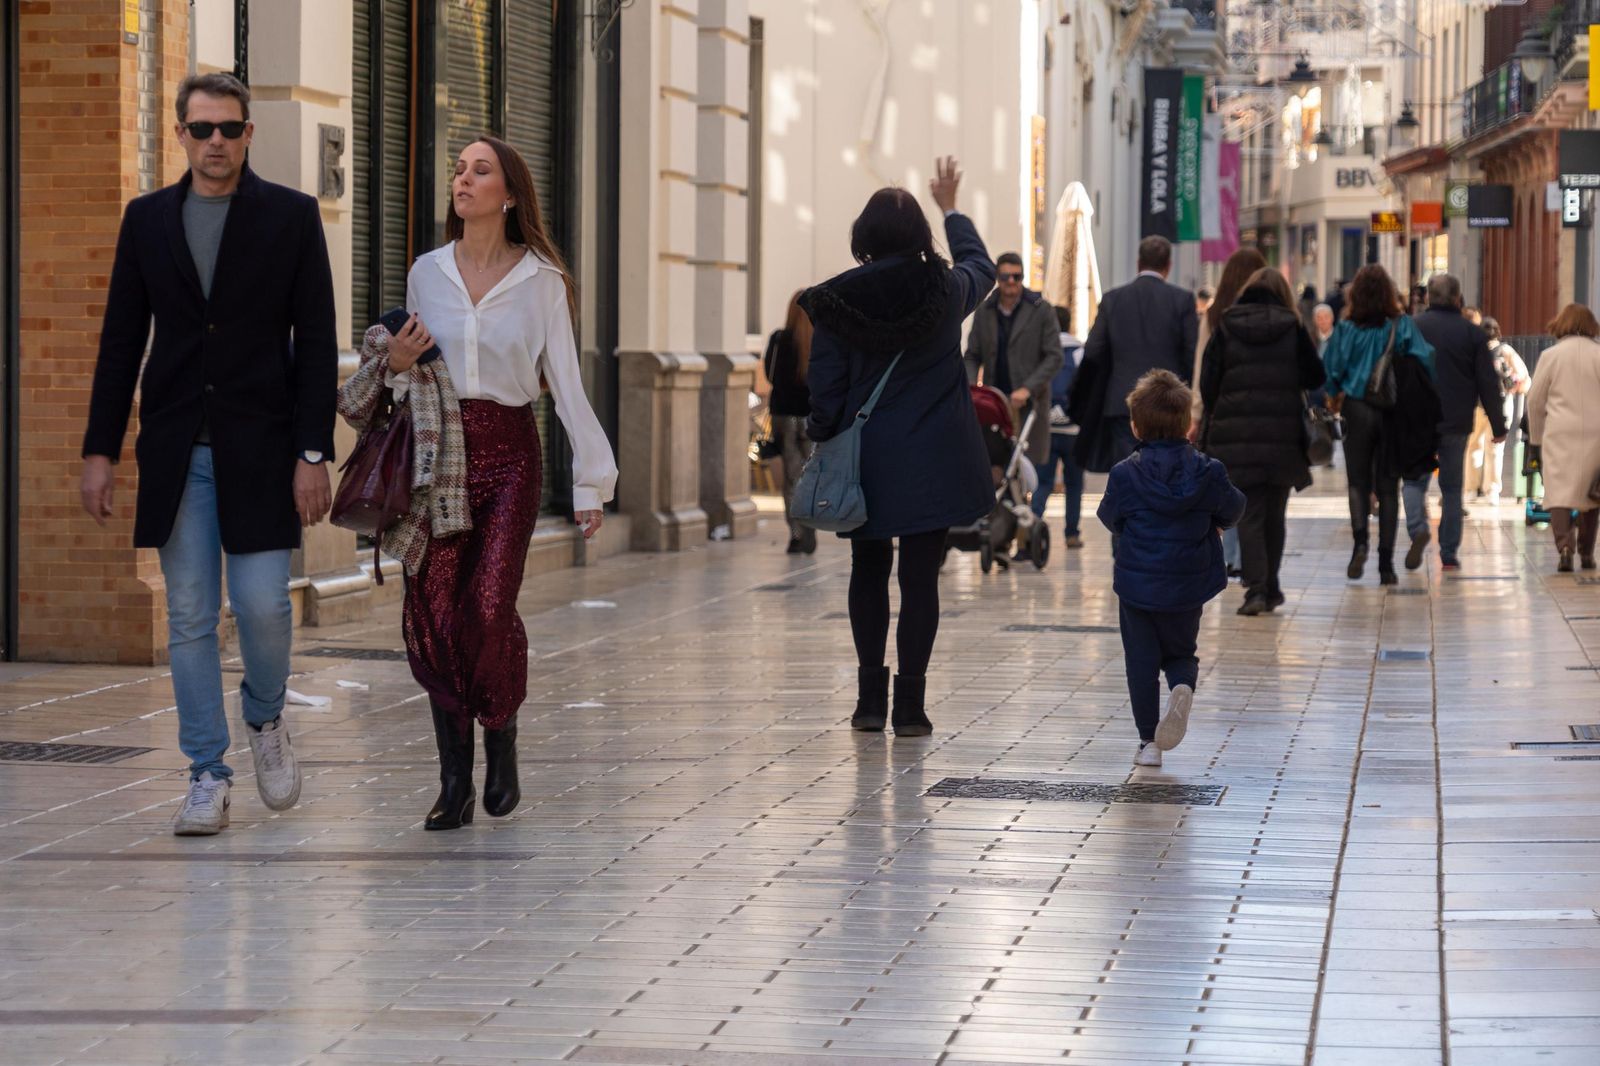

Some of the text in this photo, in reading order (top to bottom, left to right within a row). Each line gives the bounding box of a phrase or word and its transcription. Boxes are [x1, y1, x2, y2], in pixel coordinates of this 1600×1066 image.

[1151, 98, 1170, 215] BIMBA Y LOLA
